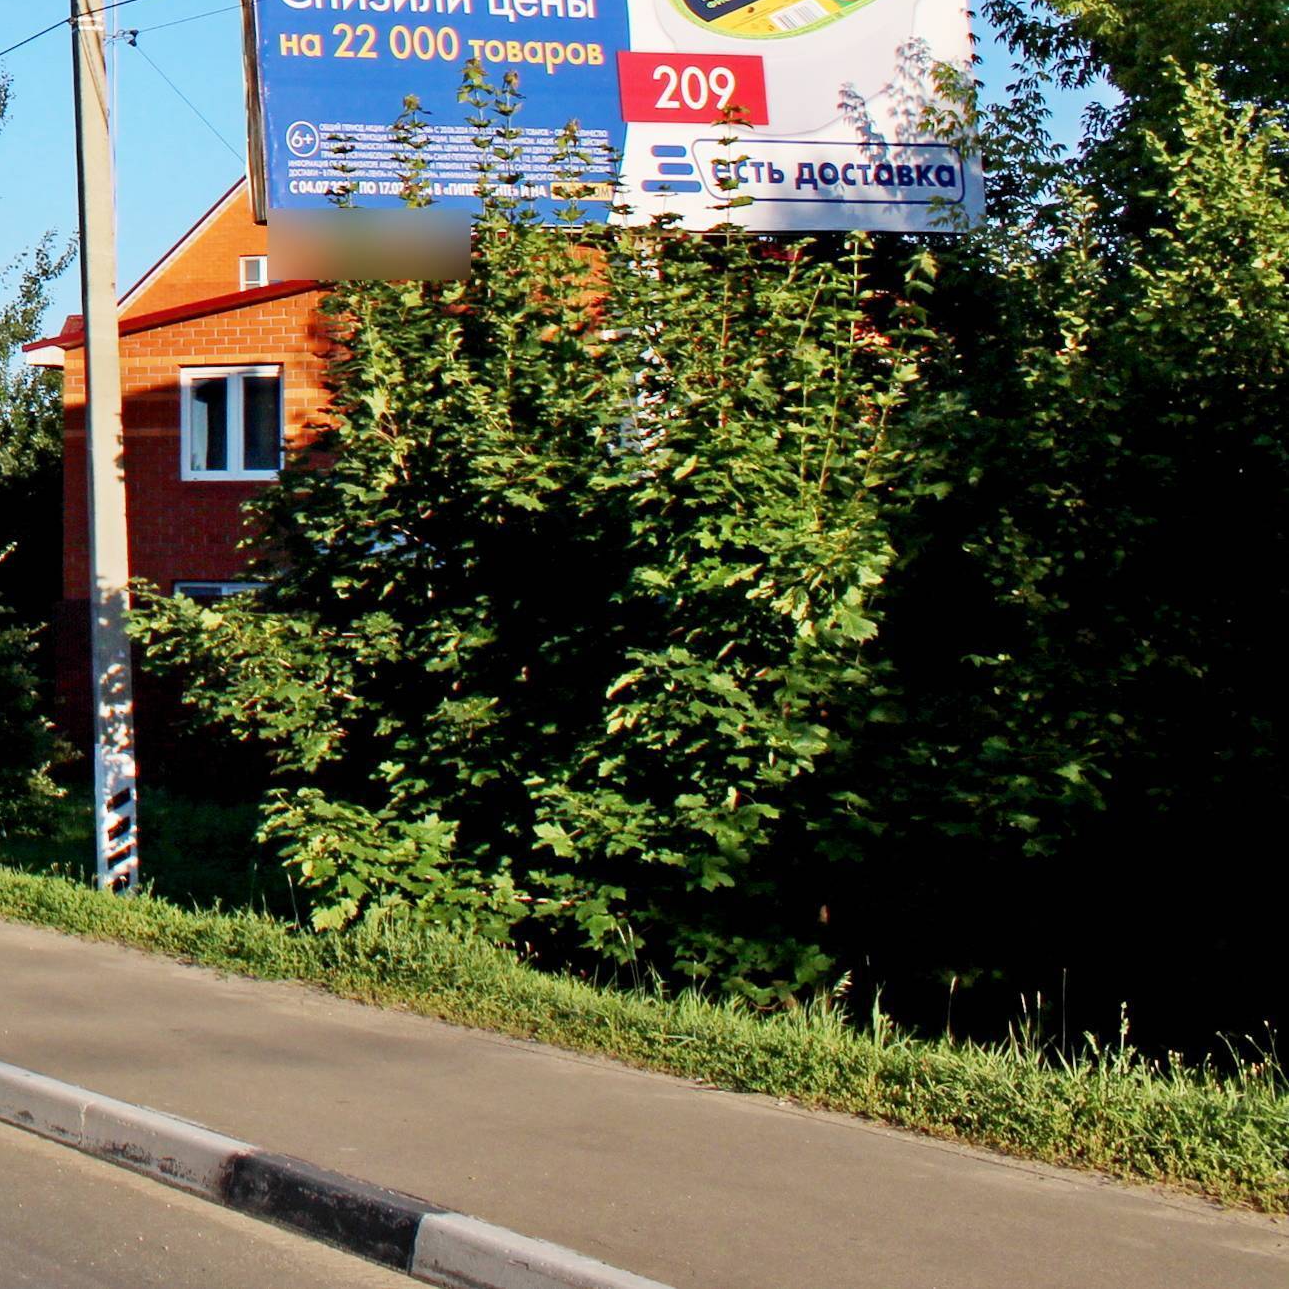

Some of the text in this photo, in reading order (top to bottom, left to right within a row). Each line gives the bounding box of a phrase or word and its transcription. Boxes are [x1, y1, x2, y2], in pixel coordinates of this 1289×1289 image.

[279, 23, 605, 75] на 22 000 товаров
[652, 65, 736, 111] 209
[291, 129, 314, 148] 6+
[359, 181, 377, 195] ПО
[795, 161, 957, 191] доставка
